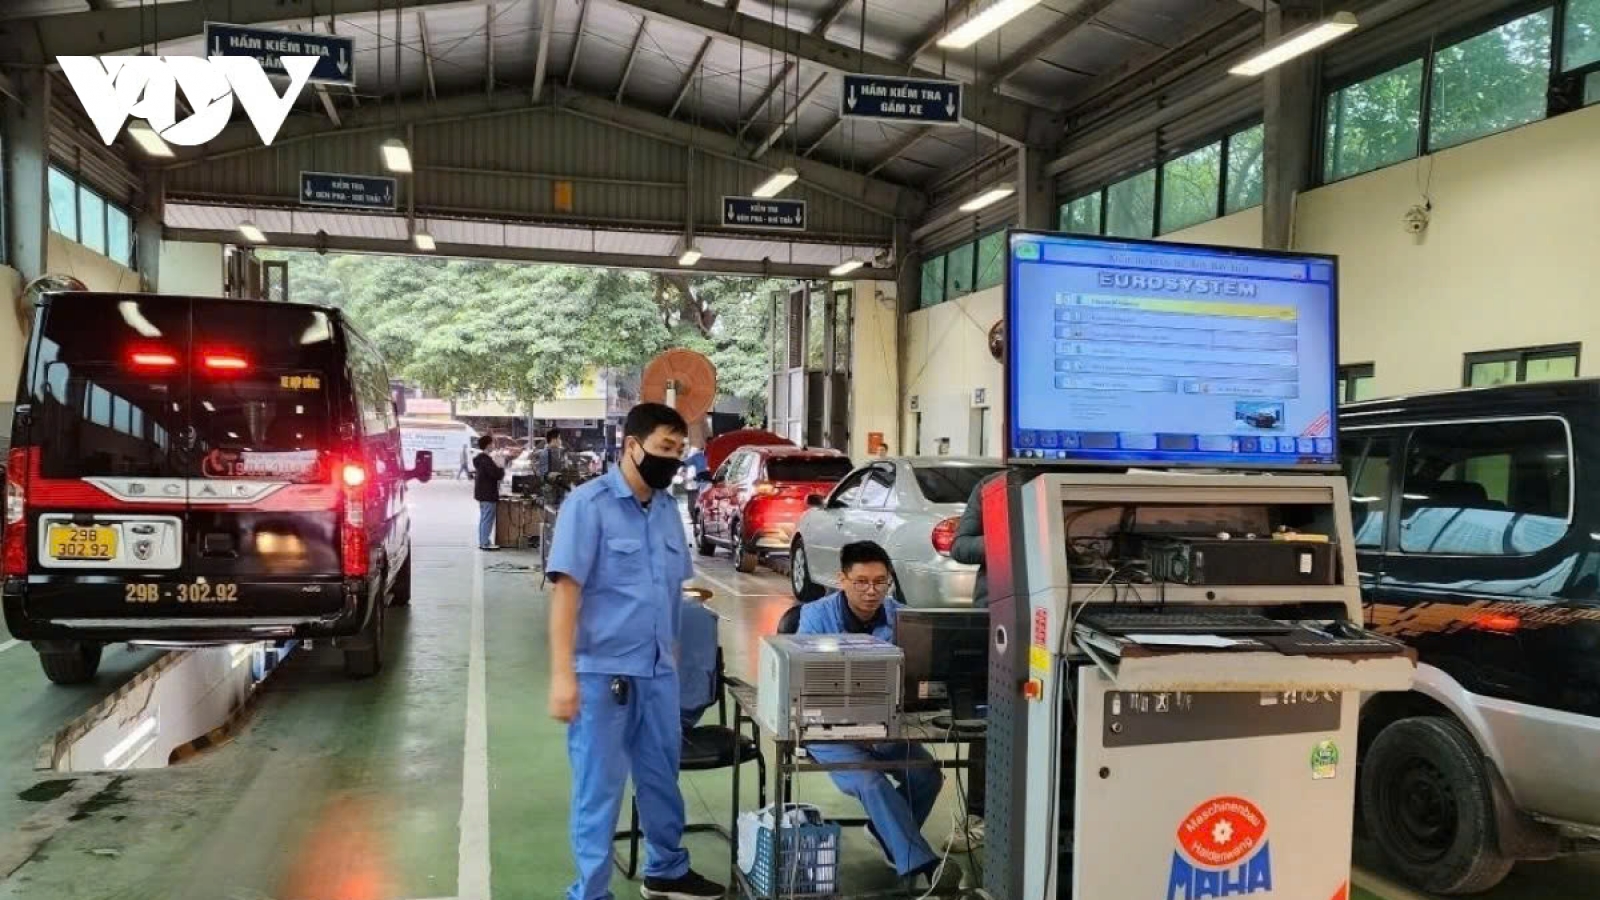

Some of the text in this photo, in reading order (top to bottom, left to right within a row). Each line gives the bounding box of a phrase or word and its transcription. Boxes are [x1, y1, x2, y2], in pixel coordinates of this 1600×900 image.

[304, 43, 330, 57] TRA
[921, 88, 942, 101] TRA
[908, 103, 924, 115] XE
[1098, 271, 1258, 298] EUROSYSTEM
[68, 529, 98, 543] 29B
[57, 543, 110, 557] 302.92
[125, 583, 160, 602] 29B
[176, 583, 239, 602] 302.92
[1185, 801, 1261, 833] Maschinenbau
[1191, 836, 1254, 862] Haldenwang
[1166, 839, 1273, 900] MAHA
